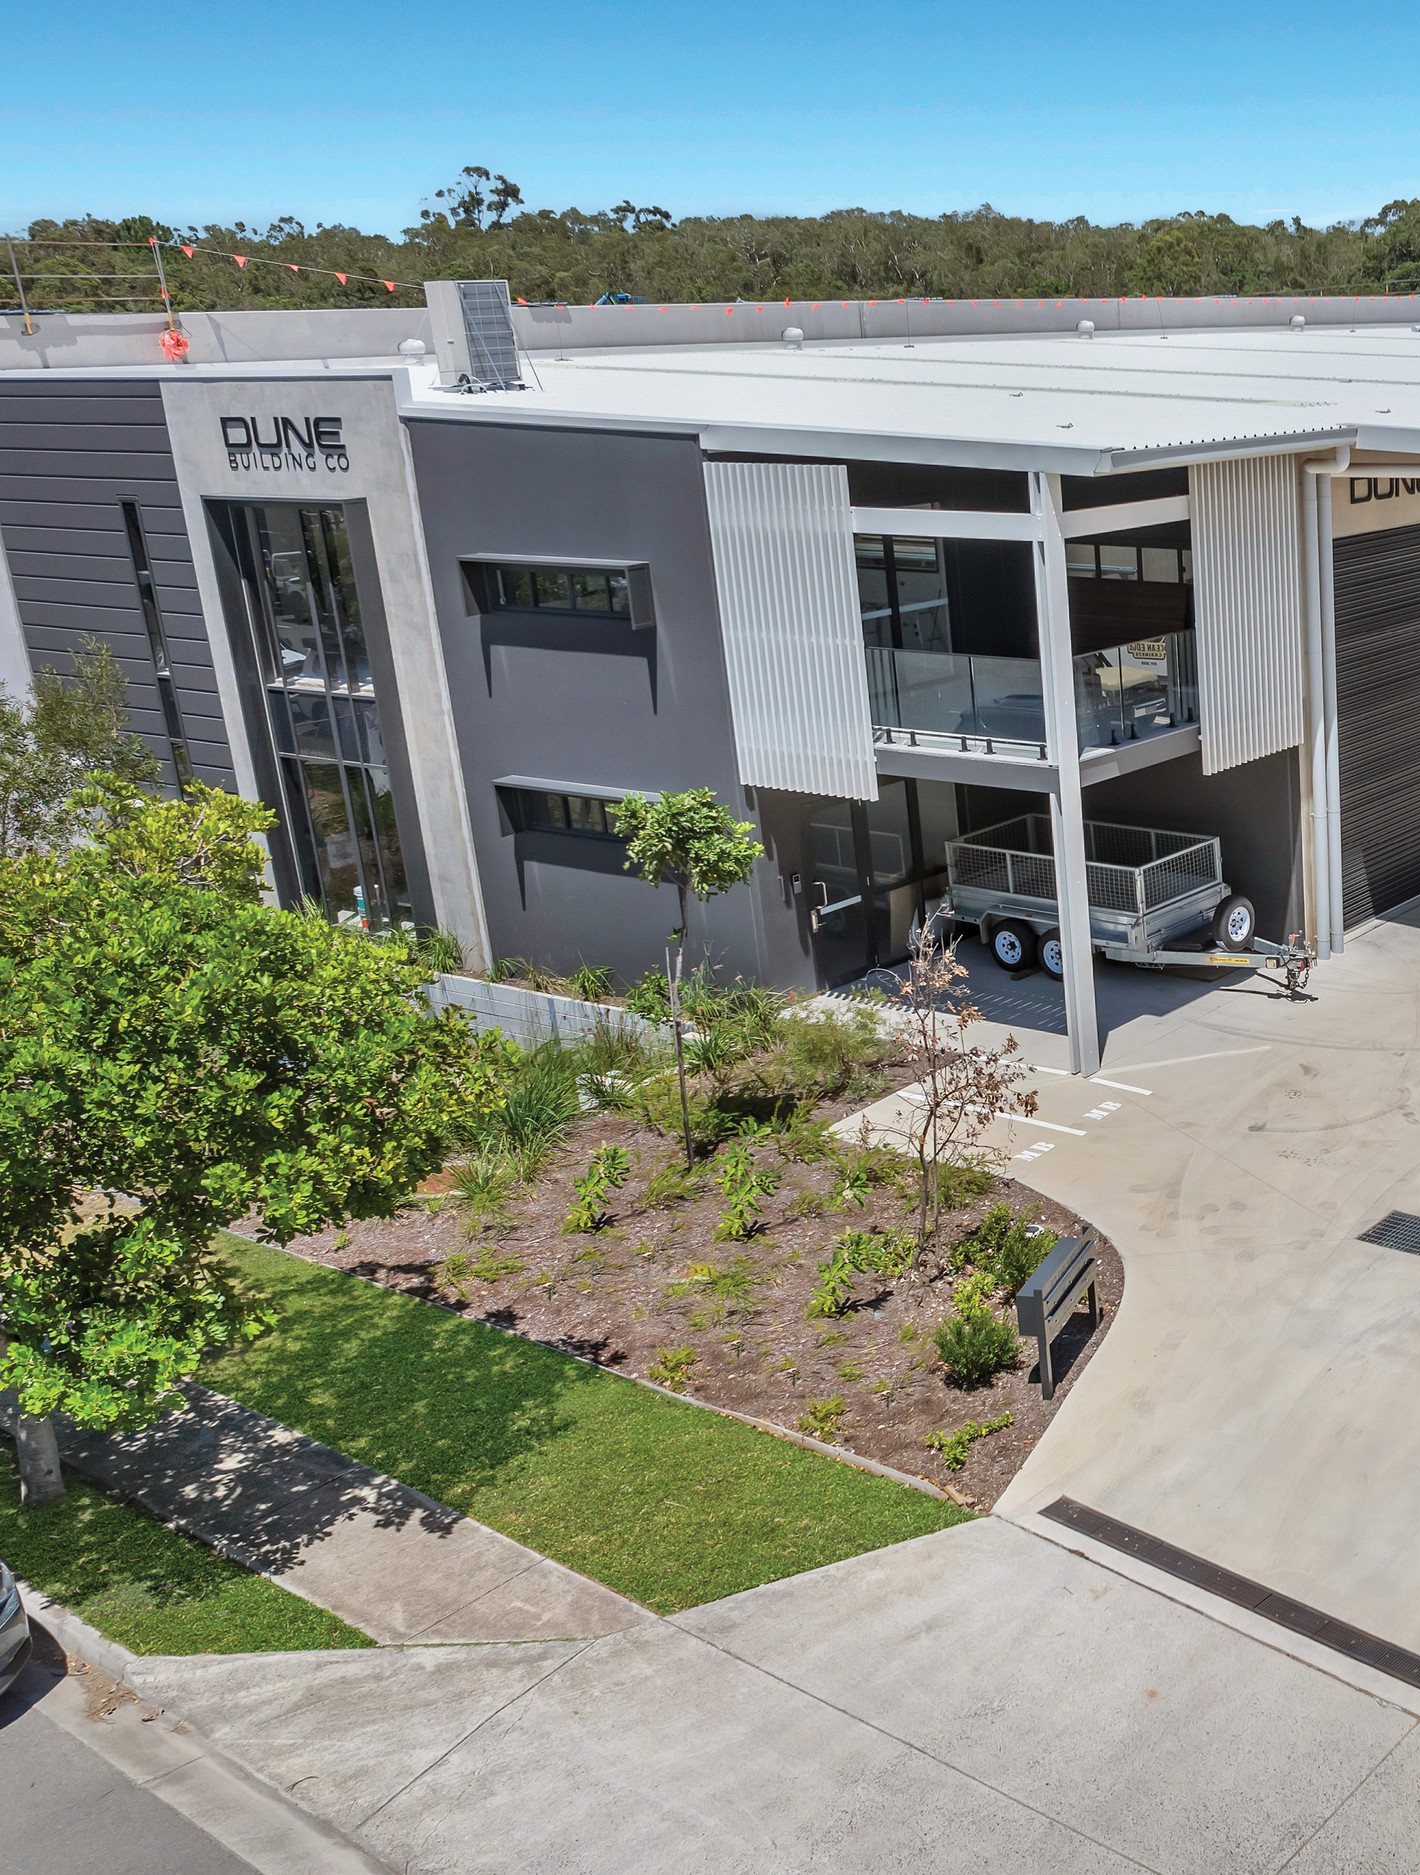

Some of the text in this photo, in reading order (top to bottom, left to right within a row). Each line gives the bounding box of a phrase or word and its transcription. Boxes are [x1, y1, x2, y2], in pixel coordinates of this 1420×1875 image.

[219, 416, 347, 453] DUNE
[228, 452, 350, 472] BUILDING CO
[1082, 1100, 1122, 1121] MB
[1014, 1141, 1056, 1162] MB
